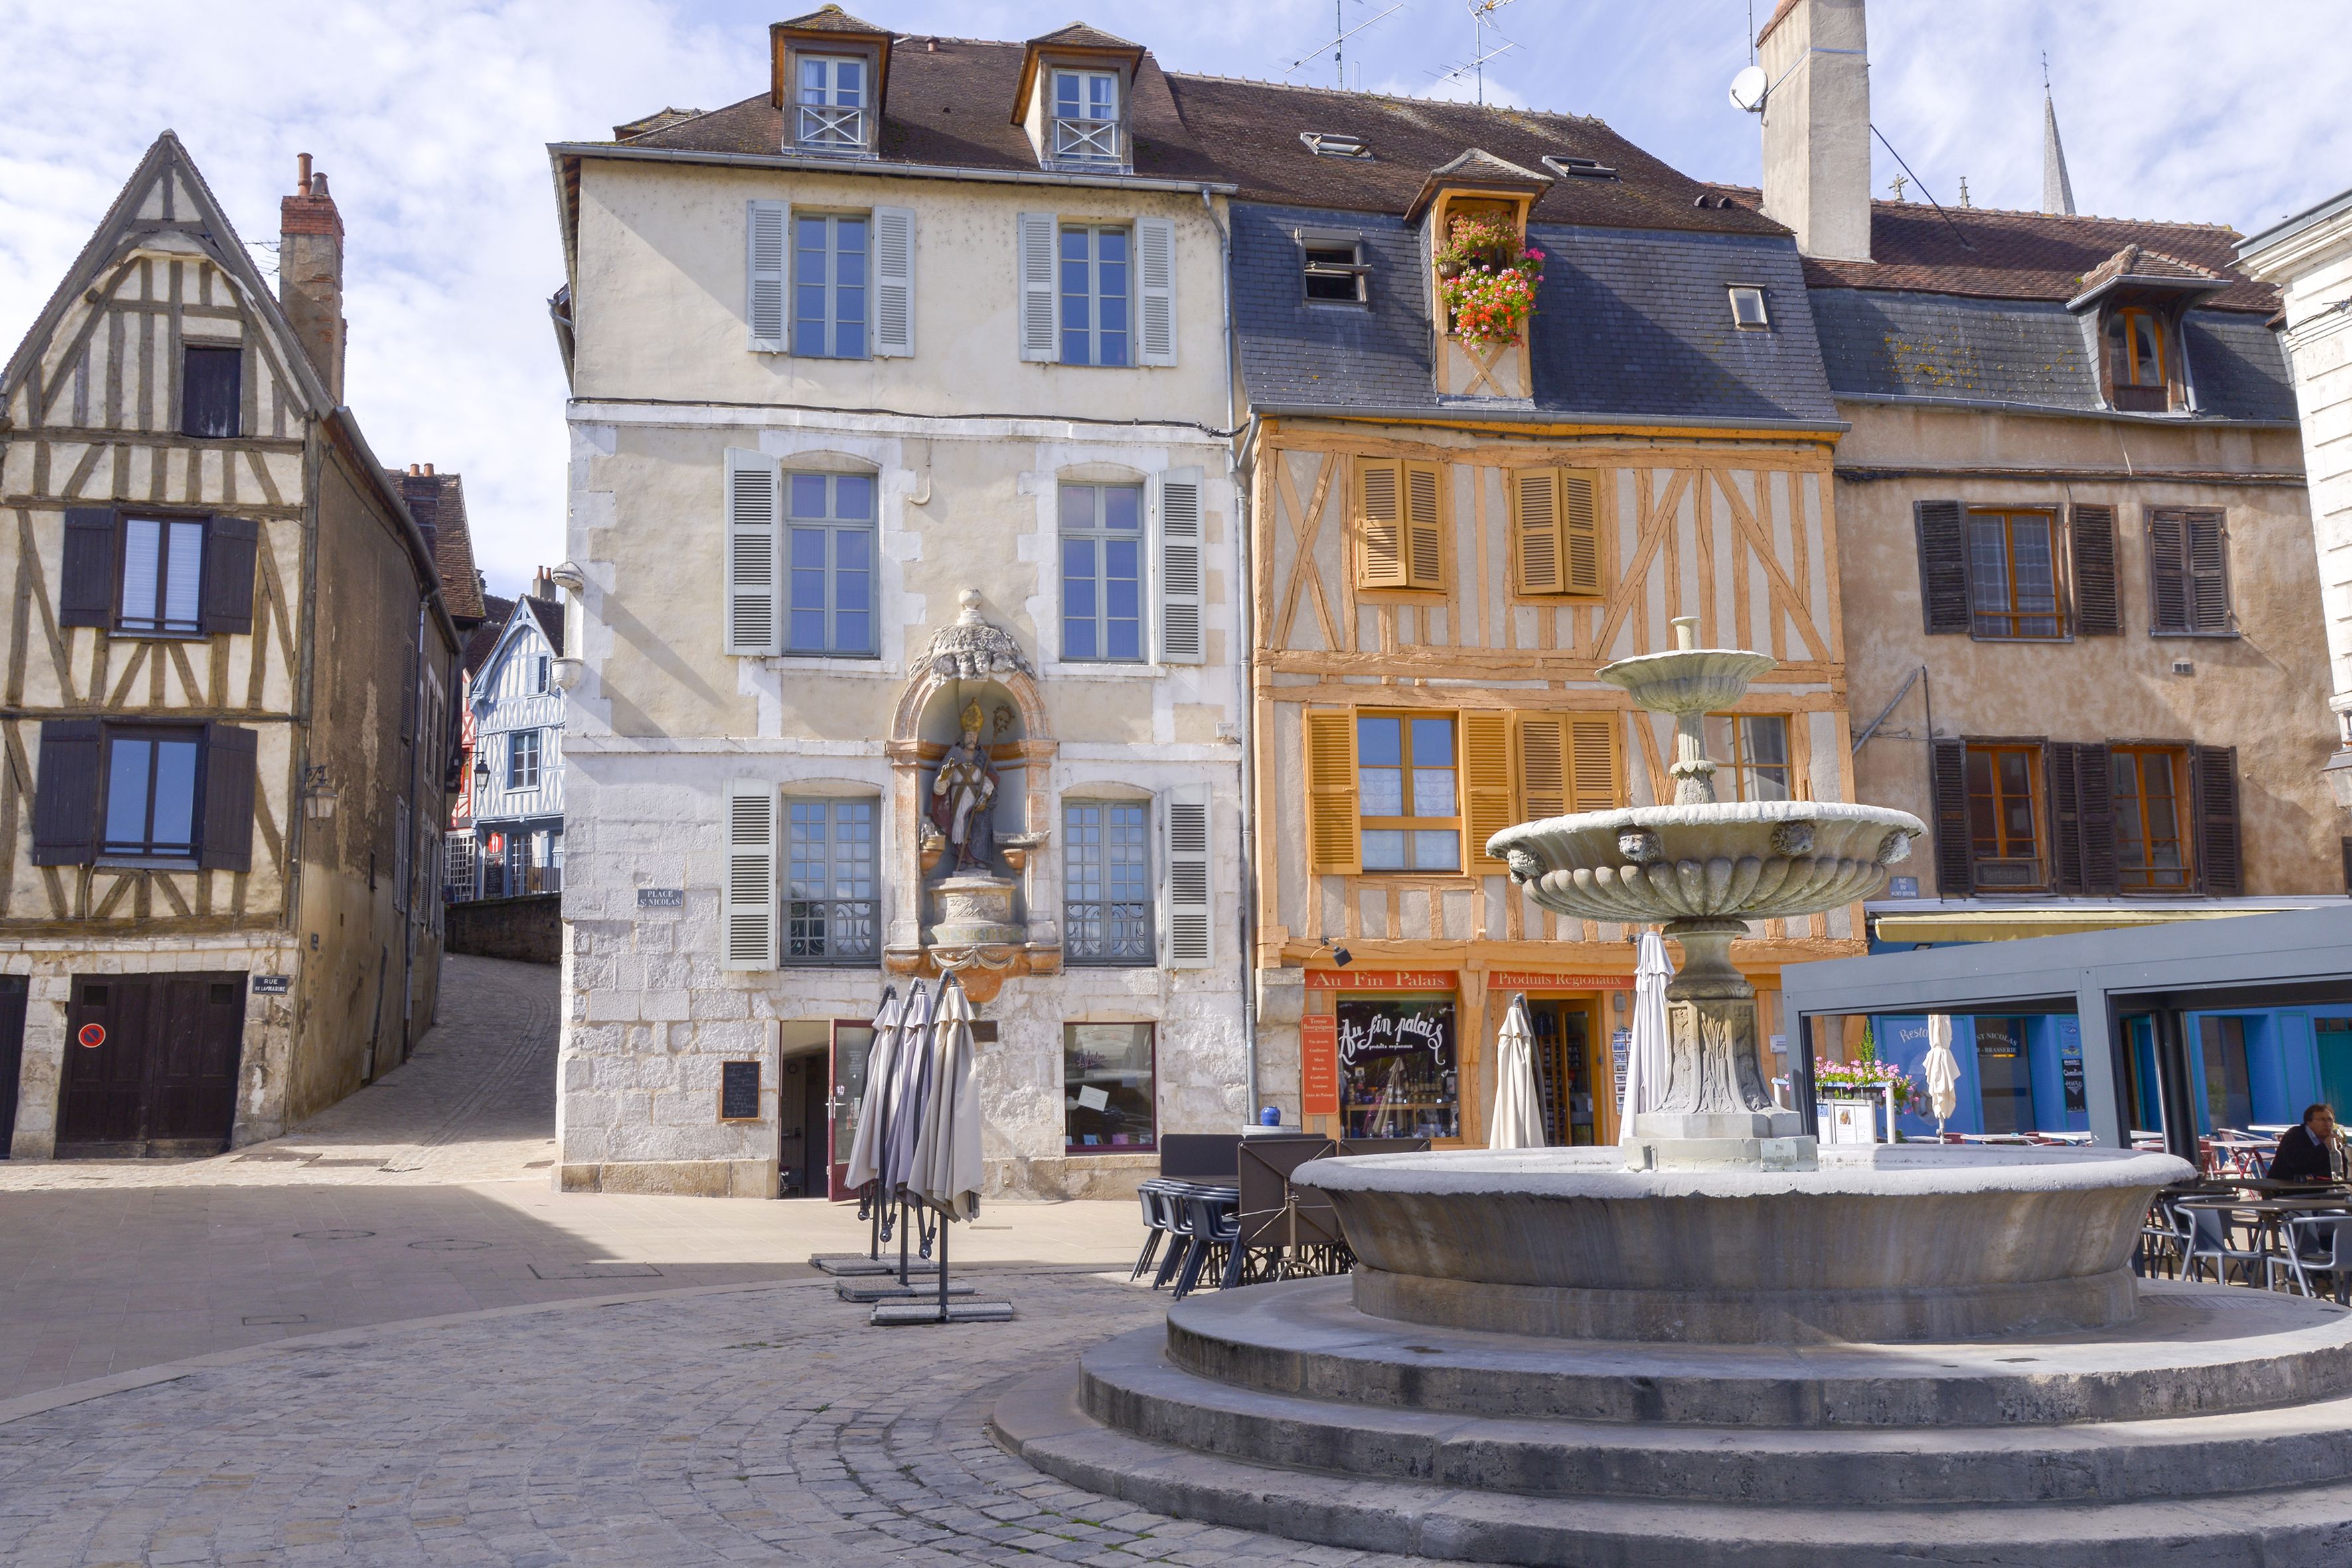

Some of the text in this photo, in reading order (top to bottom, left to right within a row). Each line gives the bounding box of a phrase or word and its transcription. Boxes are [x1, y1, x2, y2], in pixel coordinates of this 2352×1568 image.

[1313, 972, 1445, 986] Au Fin Palais
[1498, 973, 1551, 984] Produits
[1338, 1012, 1446, 1065] Au fin palais
[1899, 1026, 1928, 1044] Resta
[1986, 1032, 2017, 1046] NICOLAS
